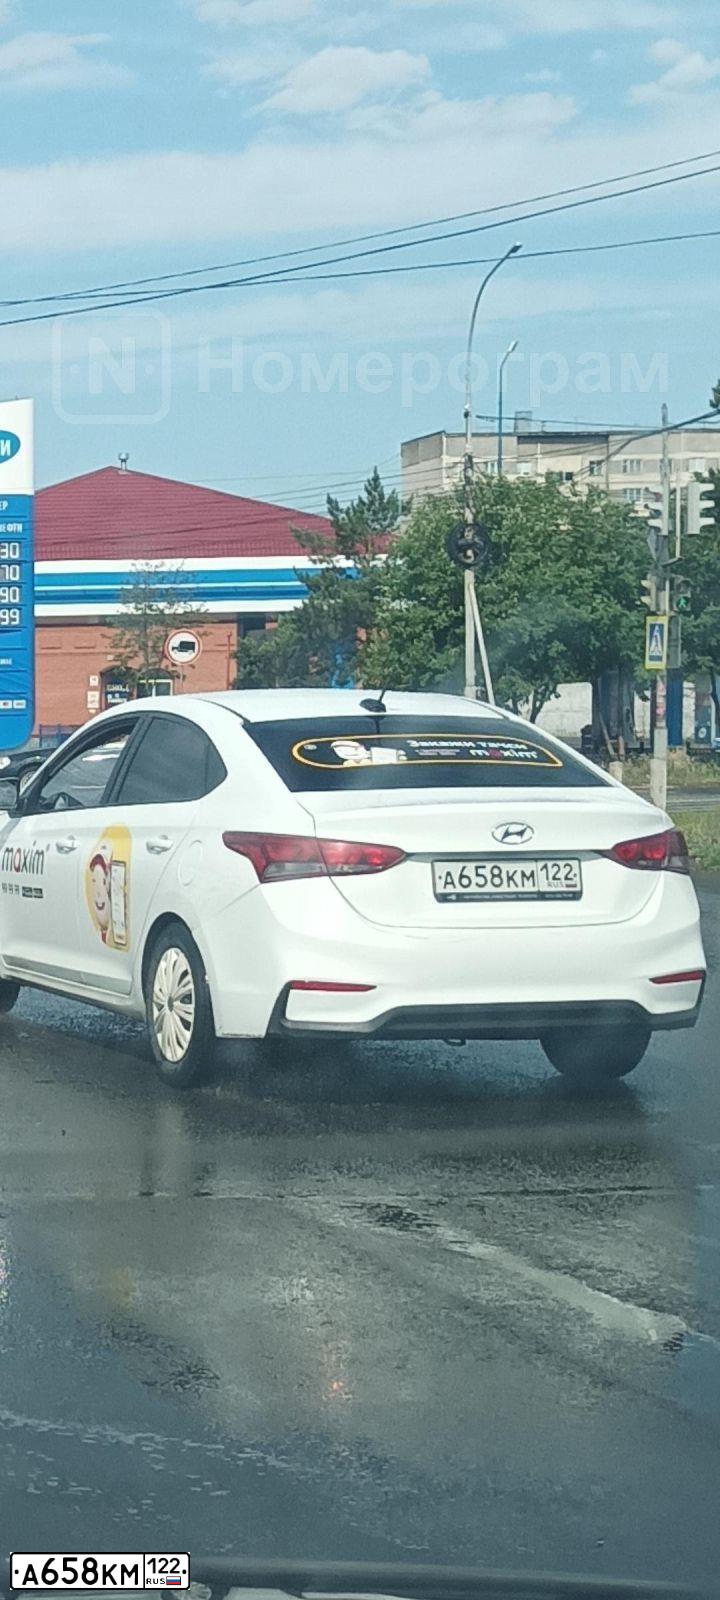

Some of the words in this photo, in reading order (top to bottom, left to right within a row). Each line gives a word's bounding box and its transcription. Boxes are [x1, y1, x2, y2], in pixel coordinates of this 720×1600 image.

[2, 840, 45, 875] maxim
[443, 865, 536, 889] А658КМ
[540, 863, 574, 881] 122
